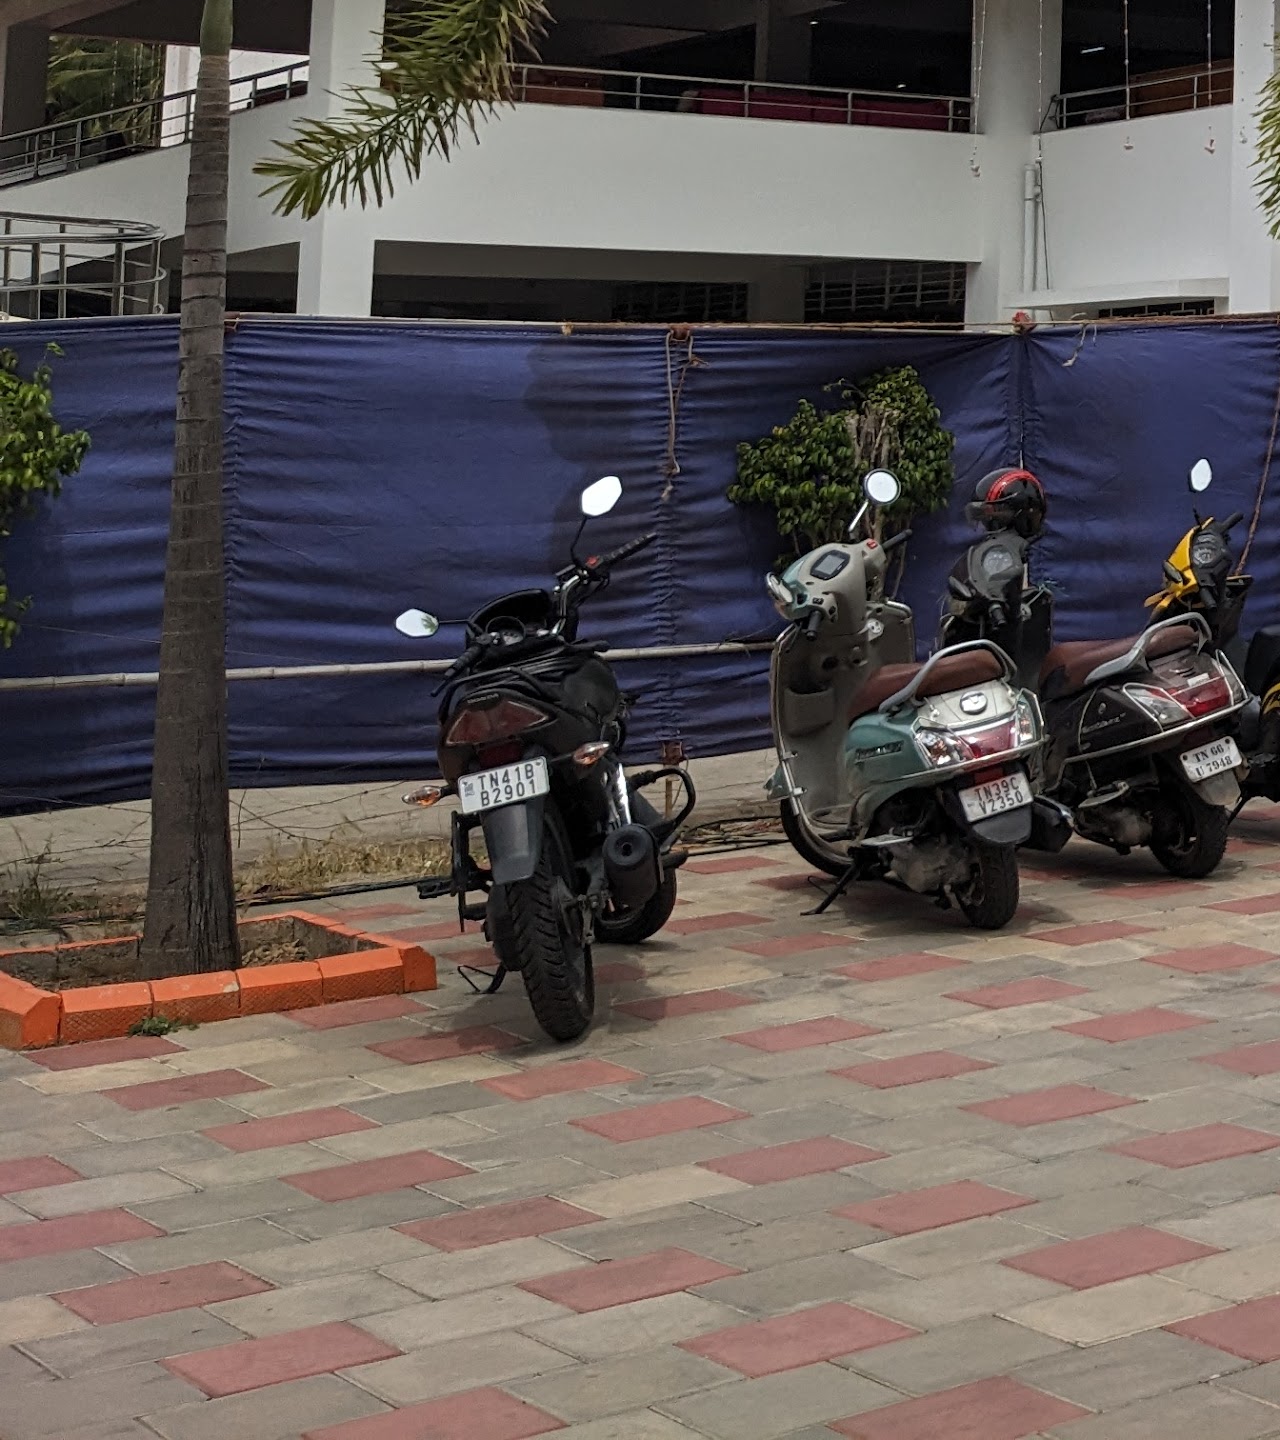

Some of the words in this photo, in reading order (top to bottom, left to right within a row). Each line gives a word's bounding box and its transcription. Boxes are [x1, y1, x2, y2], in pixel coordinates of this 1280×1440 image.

[1193, 748, 1208, 763] TN
[1207, 756, 1233, 773] 7948
[478, 763, 534, 791] TN41B
[480, 779, 536, 807] B2901
[975, 777, 1020, 802] TN39C
[979, 791, 1024, 815] V2350
